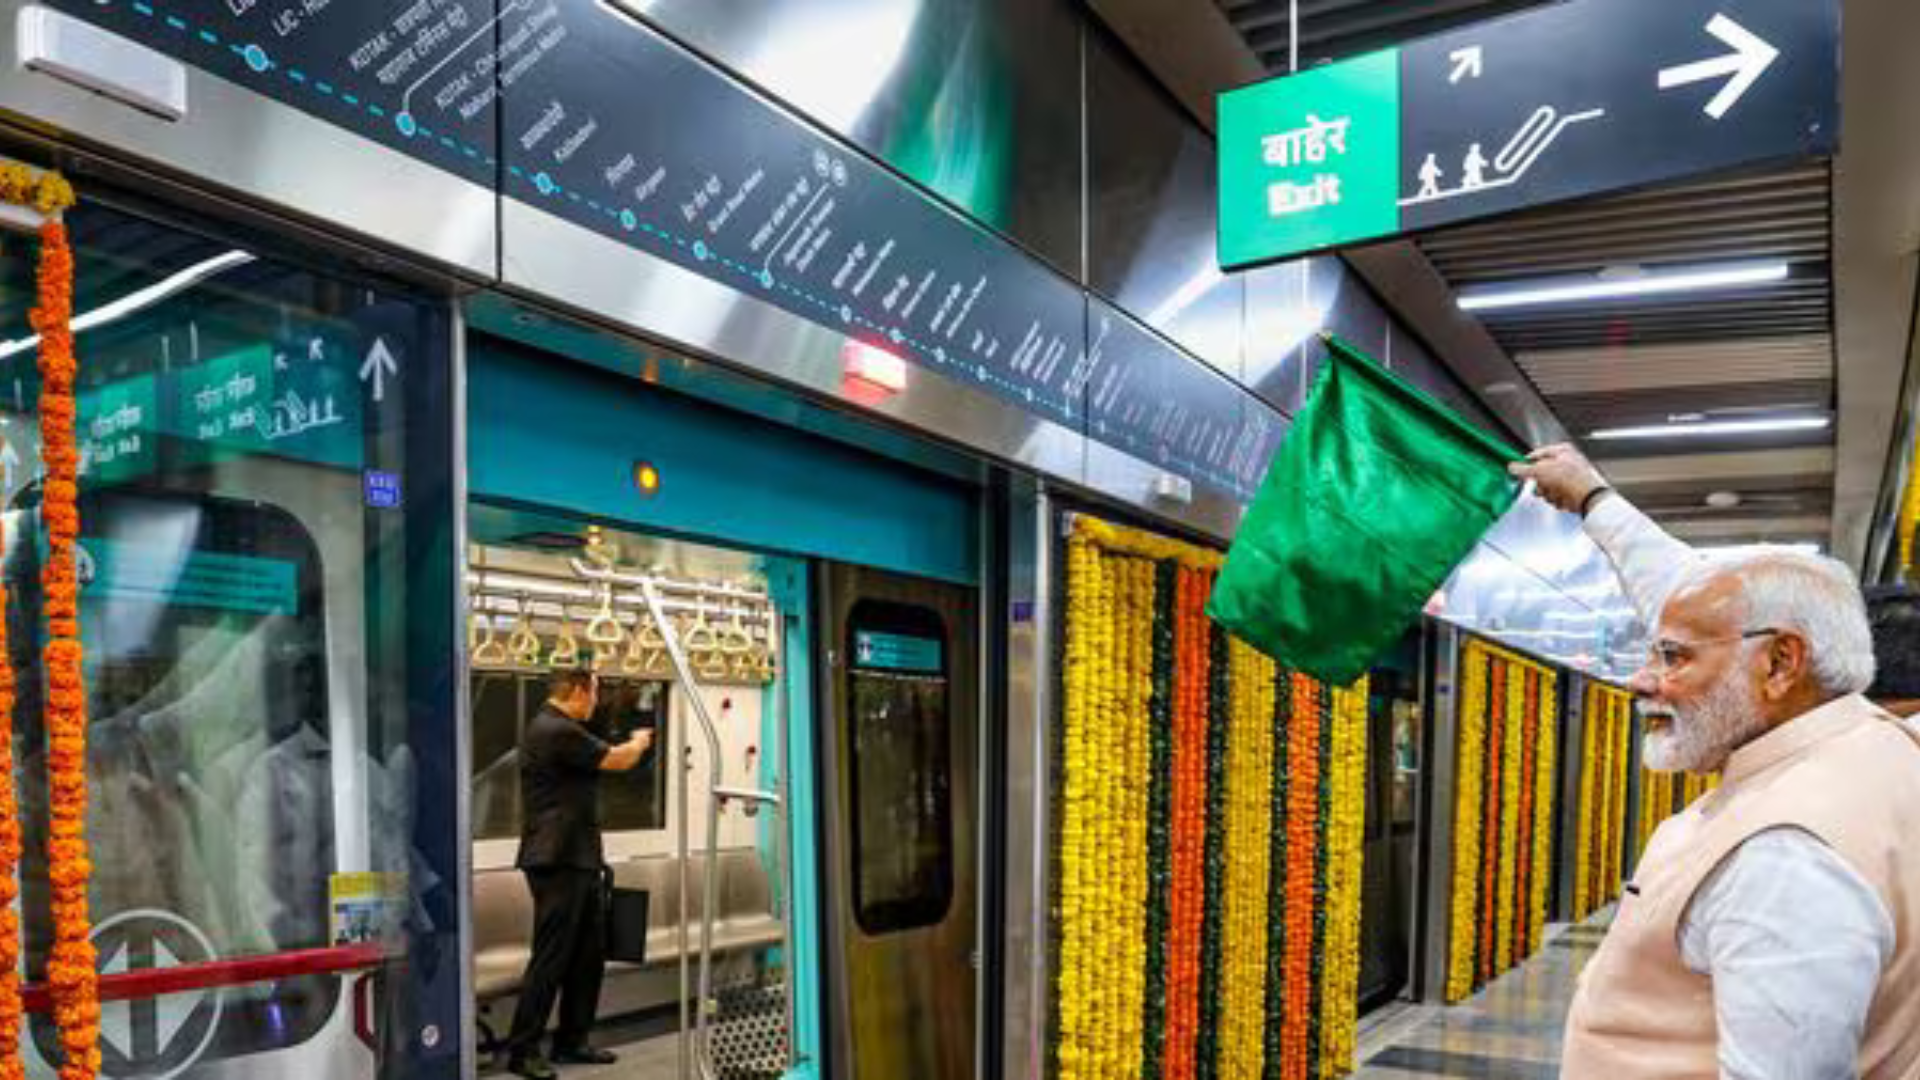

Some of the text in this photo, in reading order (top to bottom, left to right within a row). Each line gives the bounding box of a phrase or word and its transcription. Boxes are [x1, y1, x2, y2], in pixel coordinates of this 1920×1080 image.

[349, 31, 391, 70] KOTAK
[1261, 114, 1351, 167] बाहेर
[1268, 172, 1342, 217] Exit
